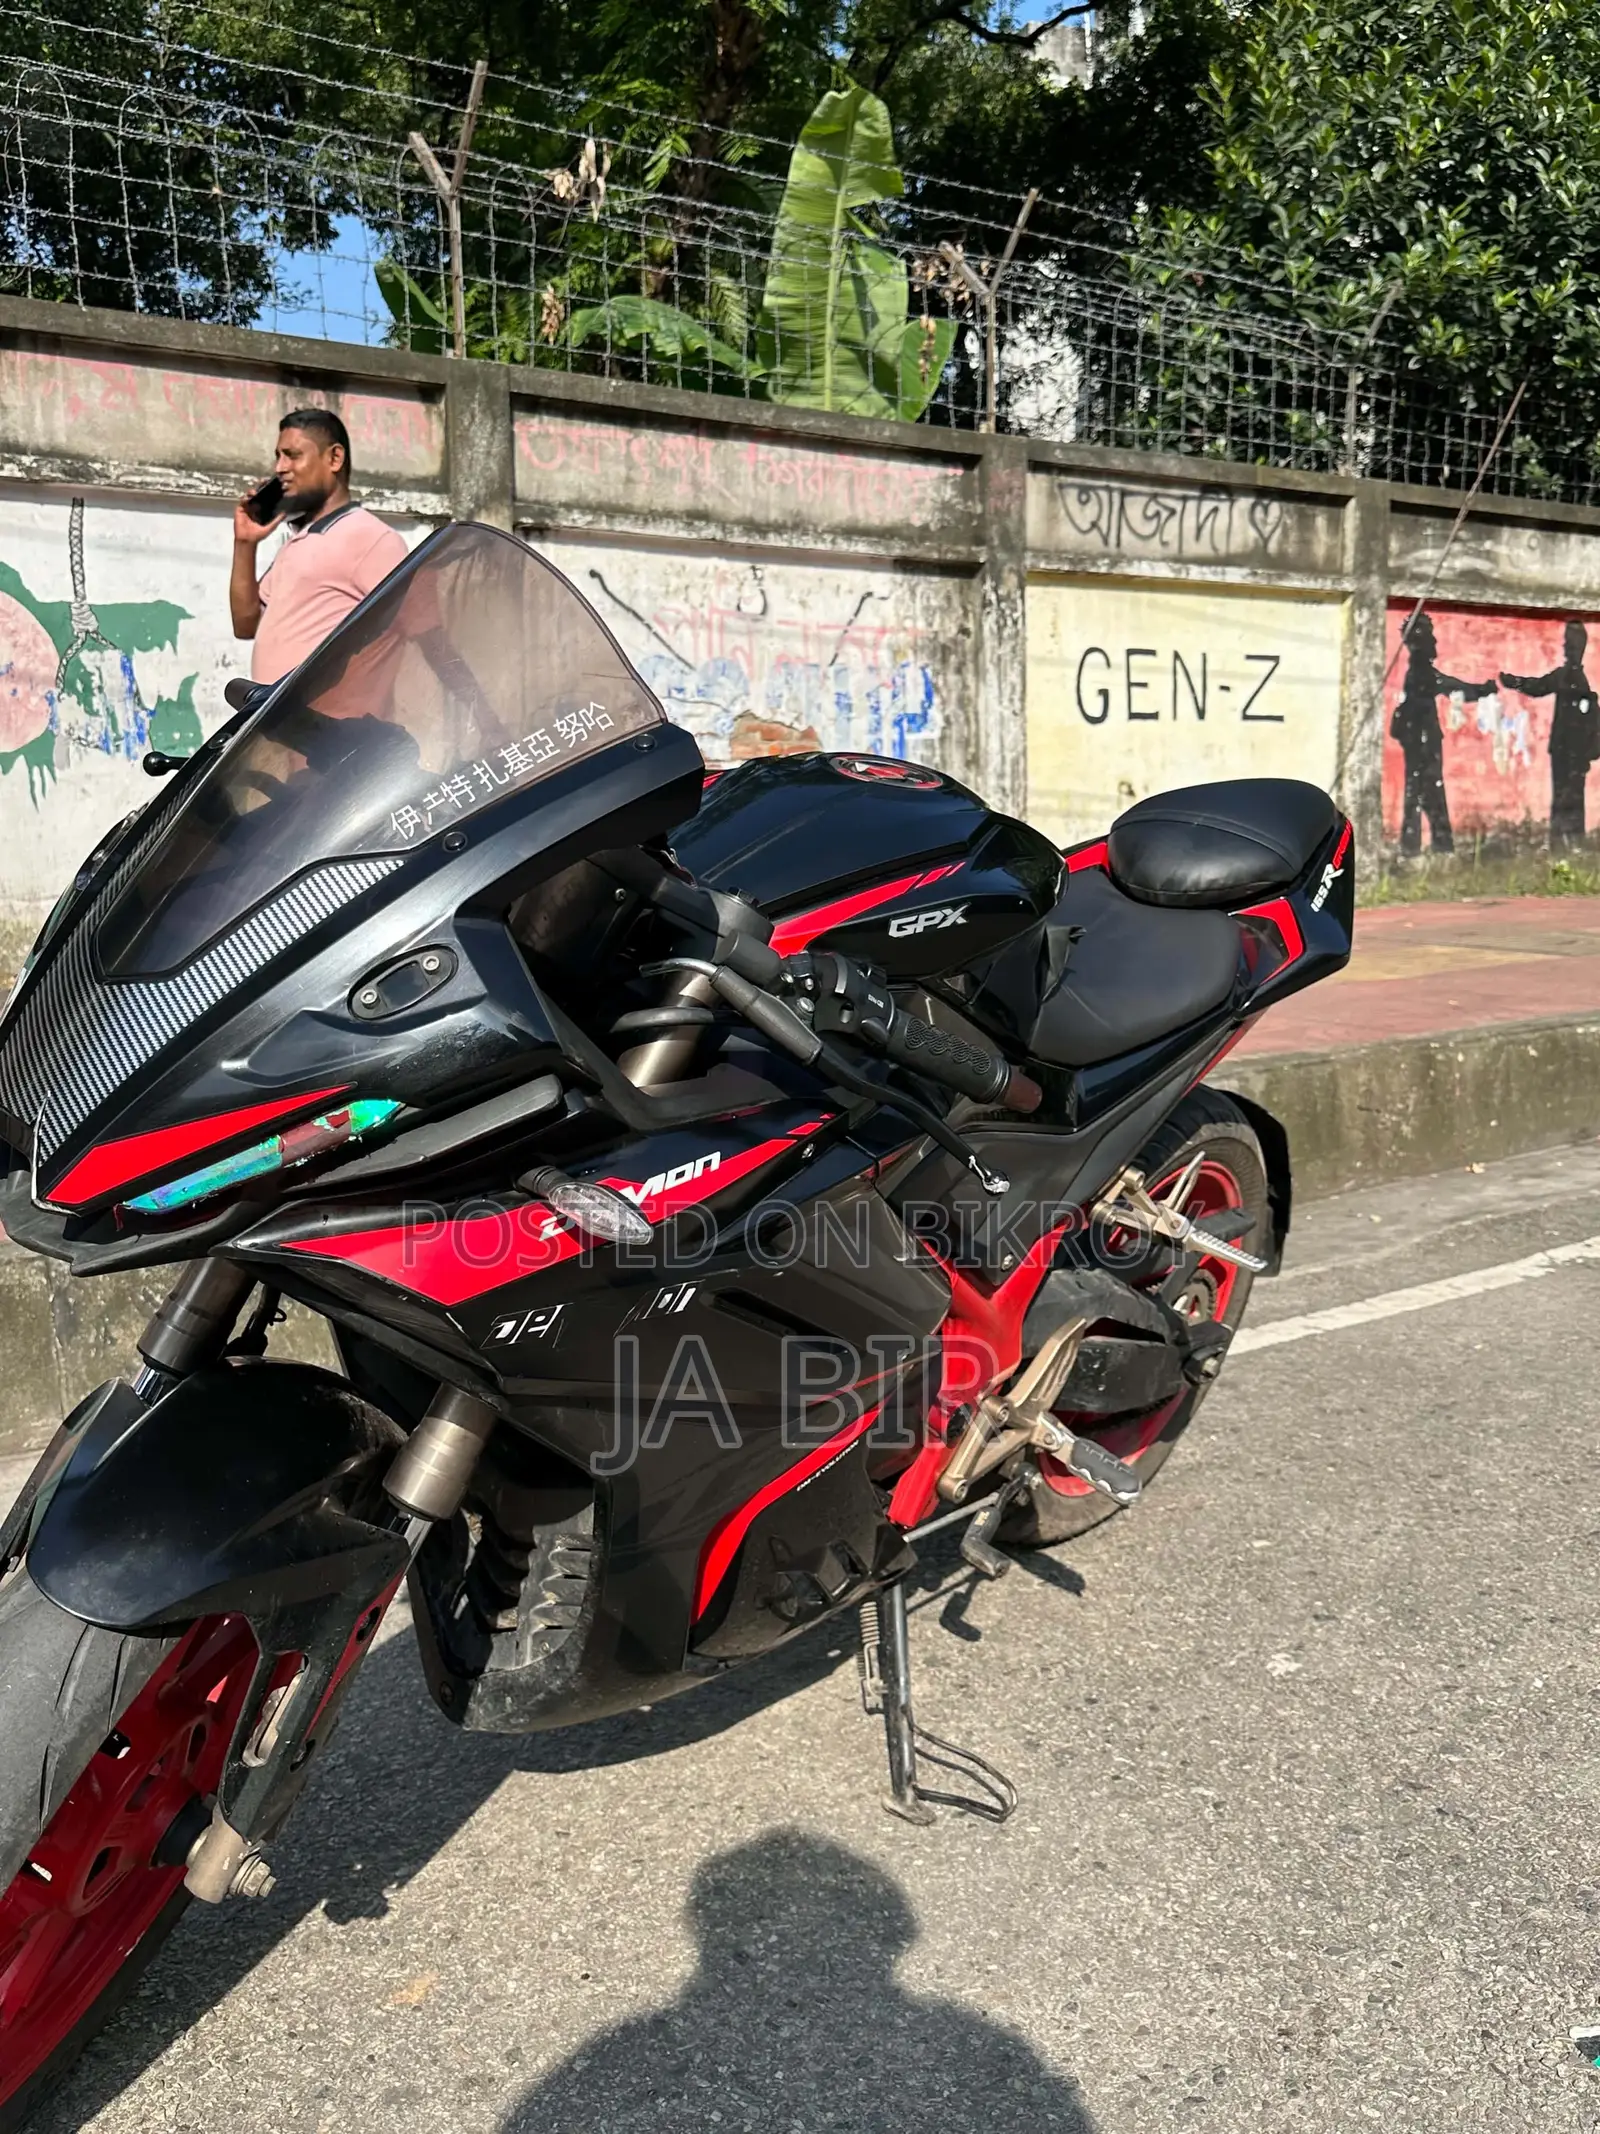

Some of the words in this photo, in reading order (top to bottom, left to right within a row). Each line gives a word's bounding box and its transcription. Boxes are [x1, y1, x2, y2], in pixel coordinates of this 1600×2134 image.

[1058, 480, 1234, 555] আজাদী
[1076, 646, 1285, 724] GEN-Z
[888, 901, 972, 938] GPX
[538, 1151, 721, 1242] DMON
